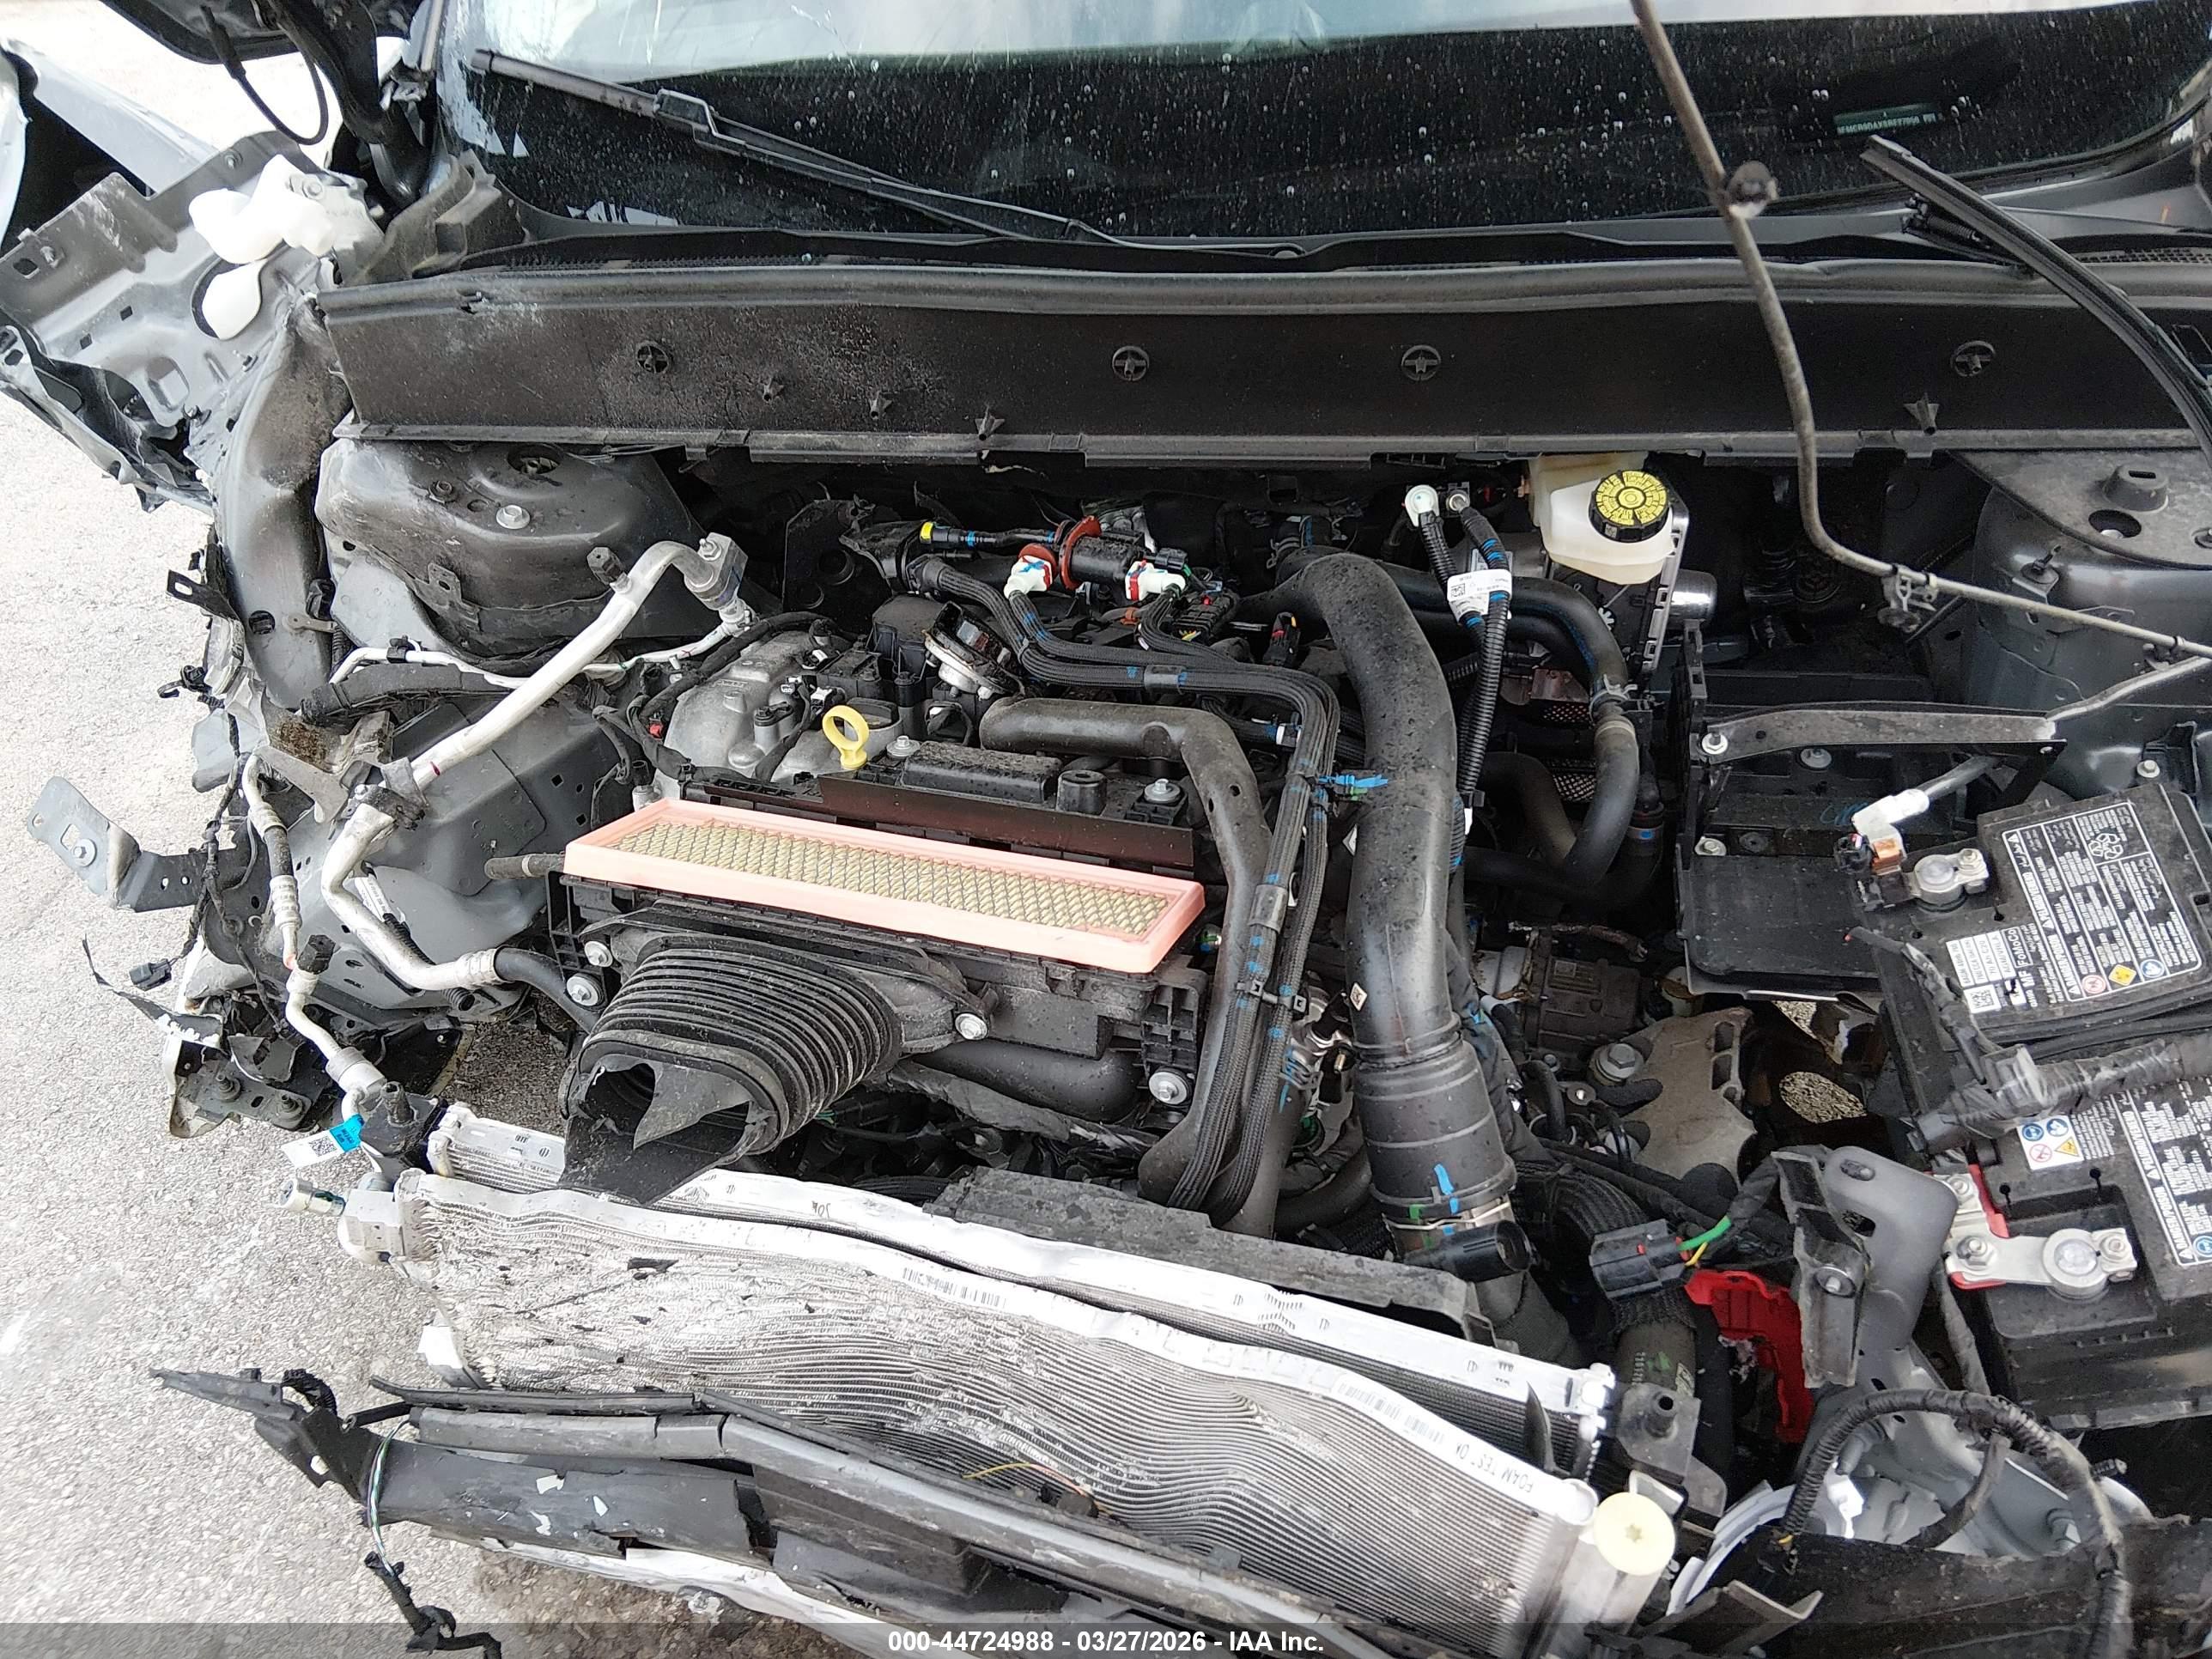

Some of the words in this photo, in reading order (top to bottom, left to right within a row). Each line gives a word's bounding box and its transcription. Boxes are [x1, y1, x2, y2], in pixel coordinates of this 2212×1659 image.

[2021, 870, 2051, 921] PELIGRO/VENENO
[2004, 928, 2029, 966] FoMoCo
[2046, 933, 2077, 987] DANGER/POISON
[2017, 968, 2035, 988] MF
[2120, 1109, 2156, 1170] PELIGRO/VENENO
[2151, 1185, 2189, 1249] DANGER/POISON
